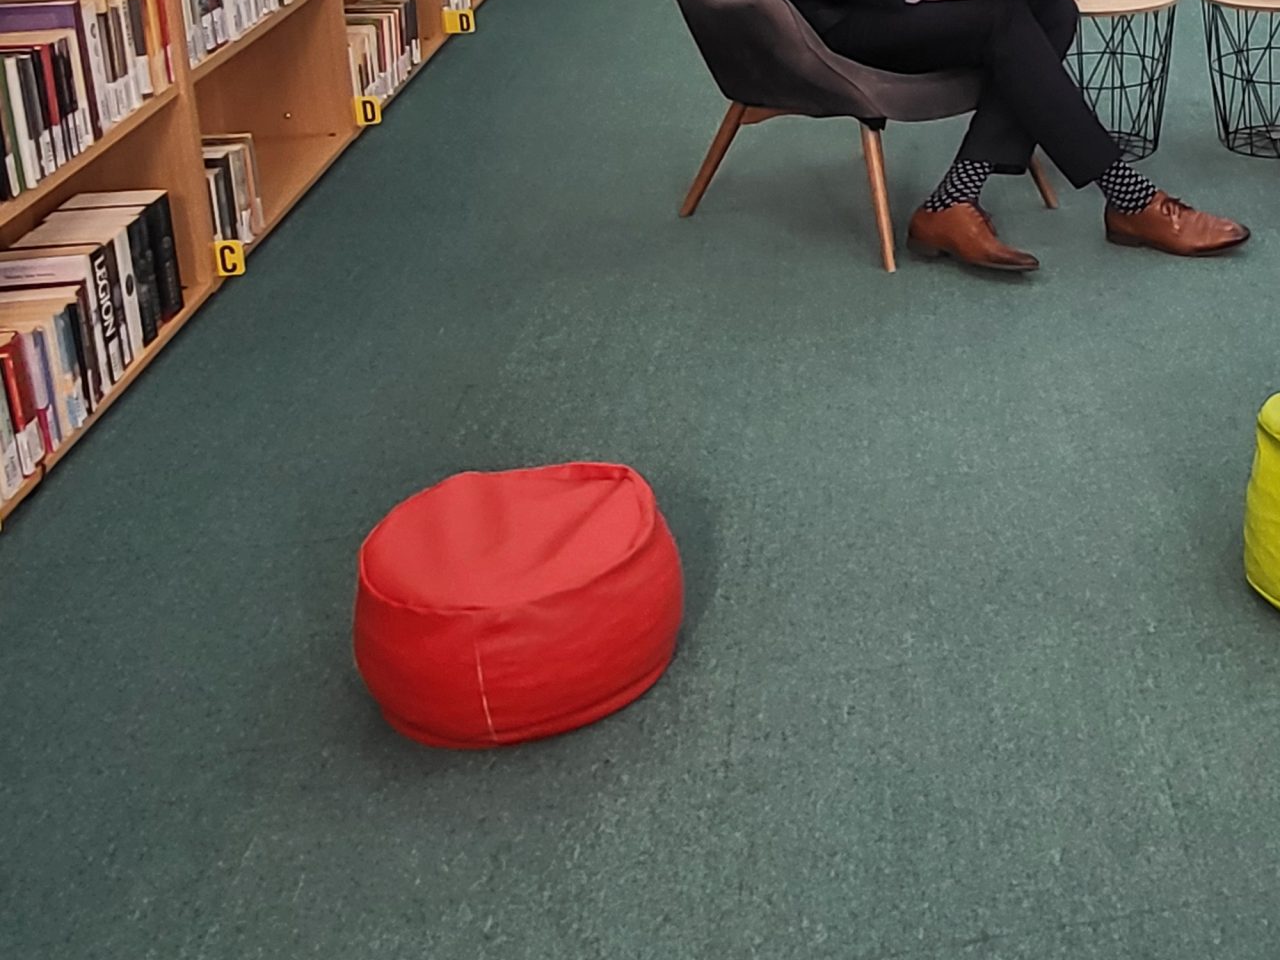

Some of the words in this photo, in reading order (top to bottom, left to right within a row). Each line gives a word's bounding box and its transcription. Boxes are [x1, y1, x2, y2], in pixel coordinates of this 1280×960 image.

[459, 13, 471, 32] D
[362, 100, 376, 122] D
[220, 245, 237, 274] C
[93, 255, 117, 338] LEGION
